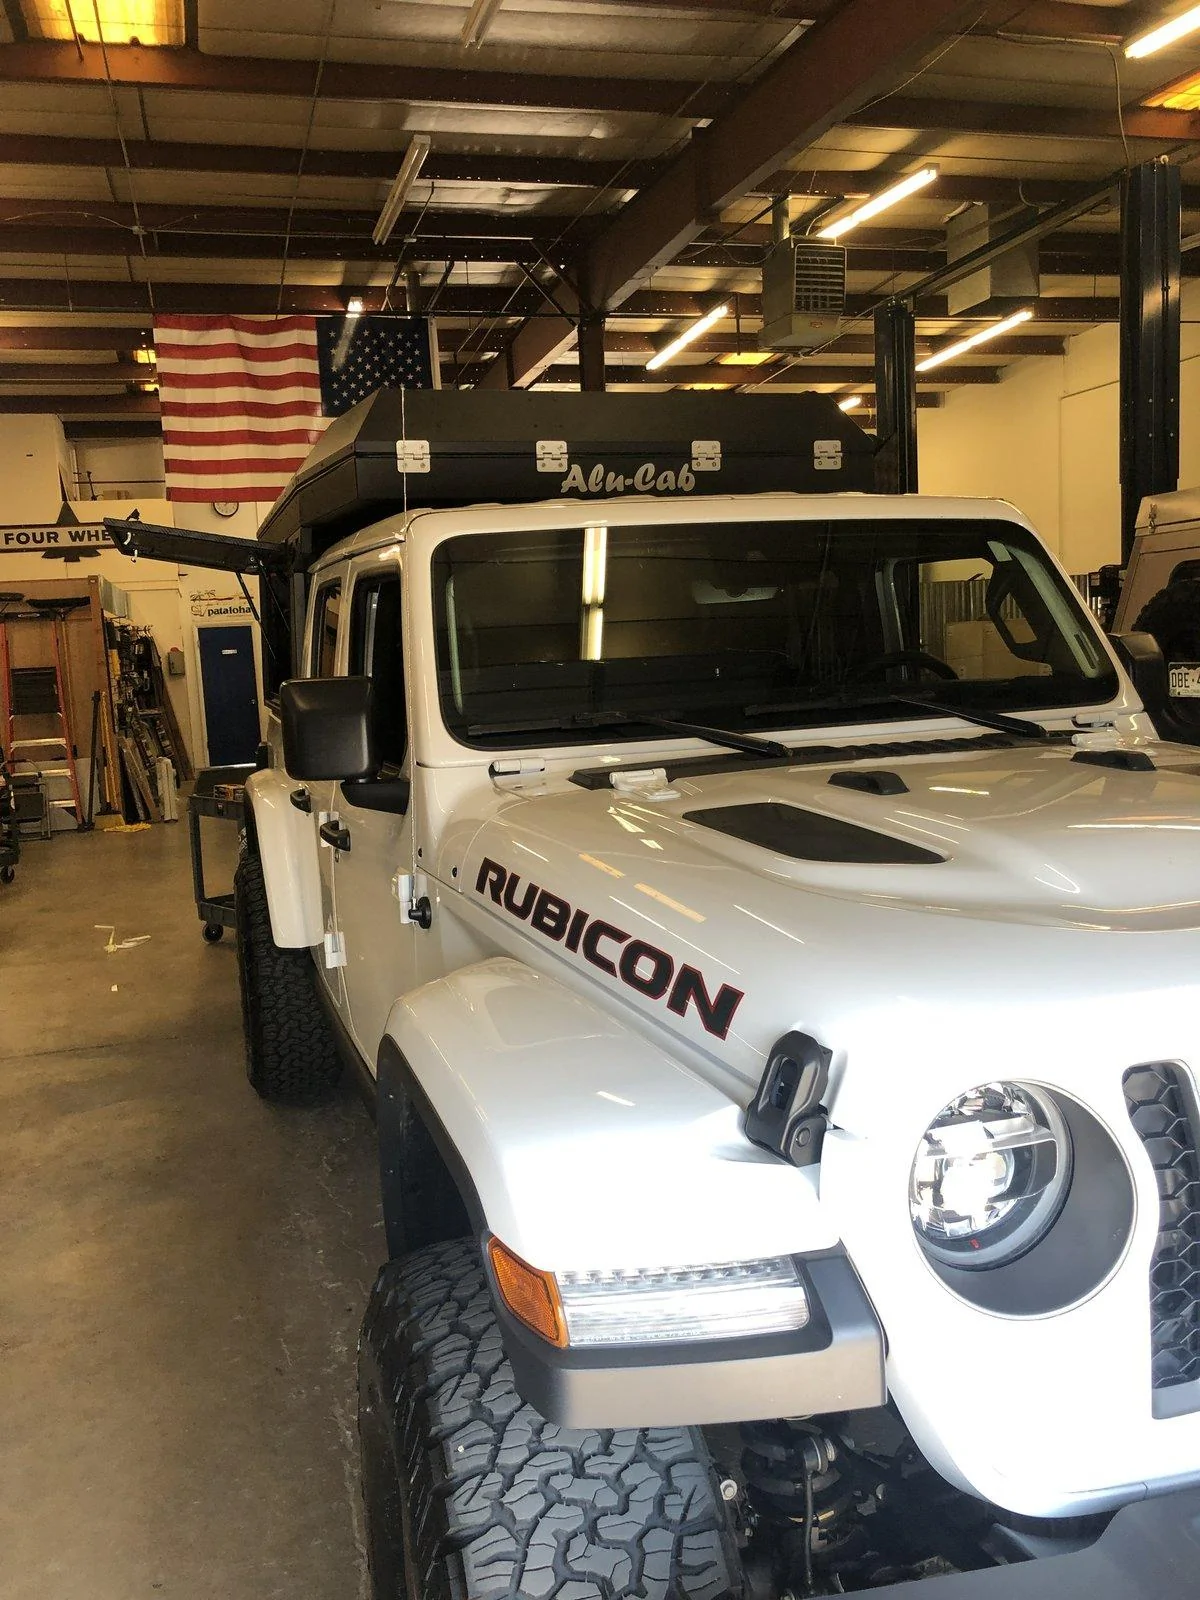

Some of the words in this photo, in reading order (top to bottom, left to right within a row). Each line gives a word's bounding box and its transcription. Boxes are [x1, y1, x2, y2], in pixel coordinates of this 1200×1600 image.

[560, 463, 696, 493] Alu-Cab
[4, 531, 60, 545] FOUR
[475, 856, 744, 1041] RUBICON
